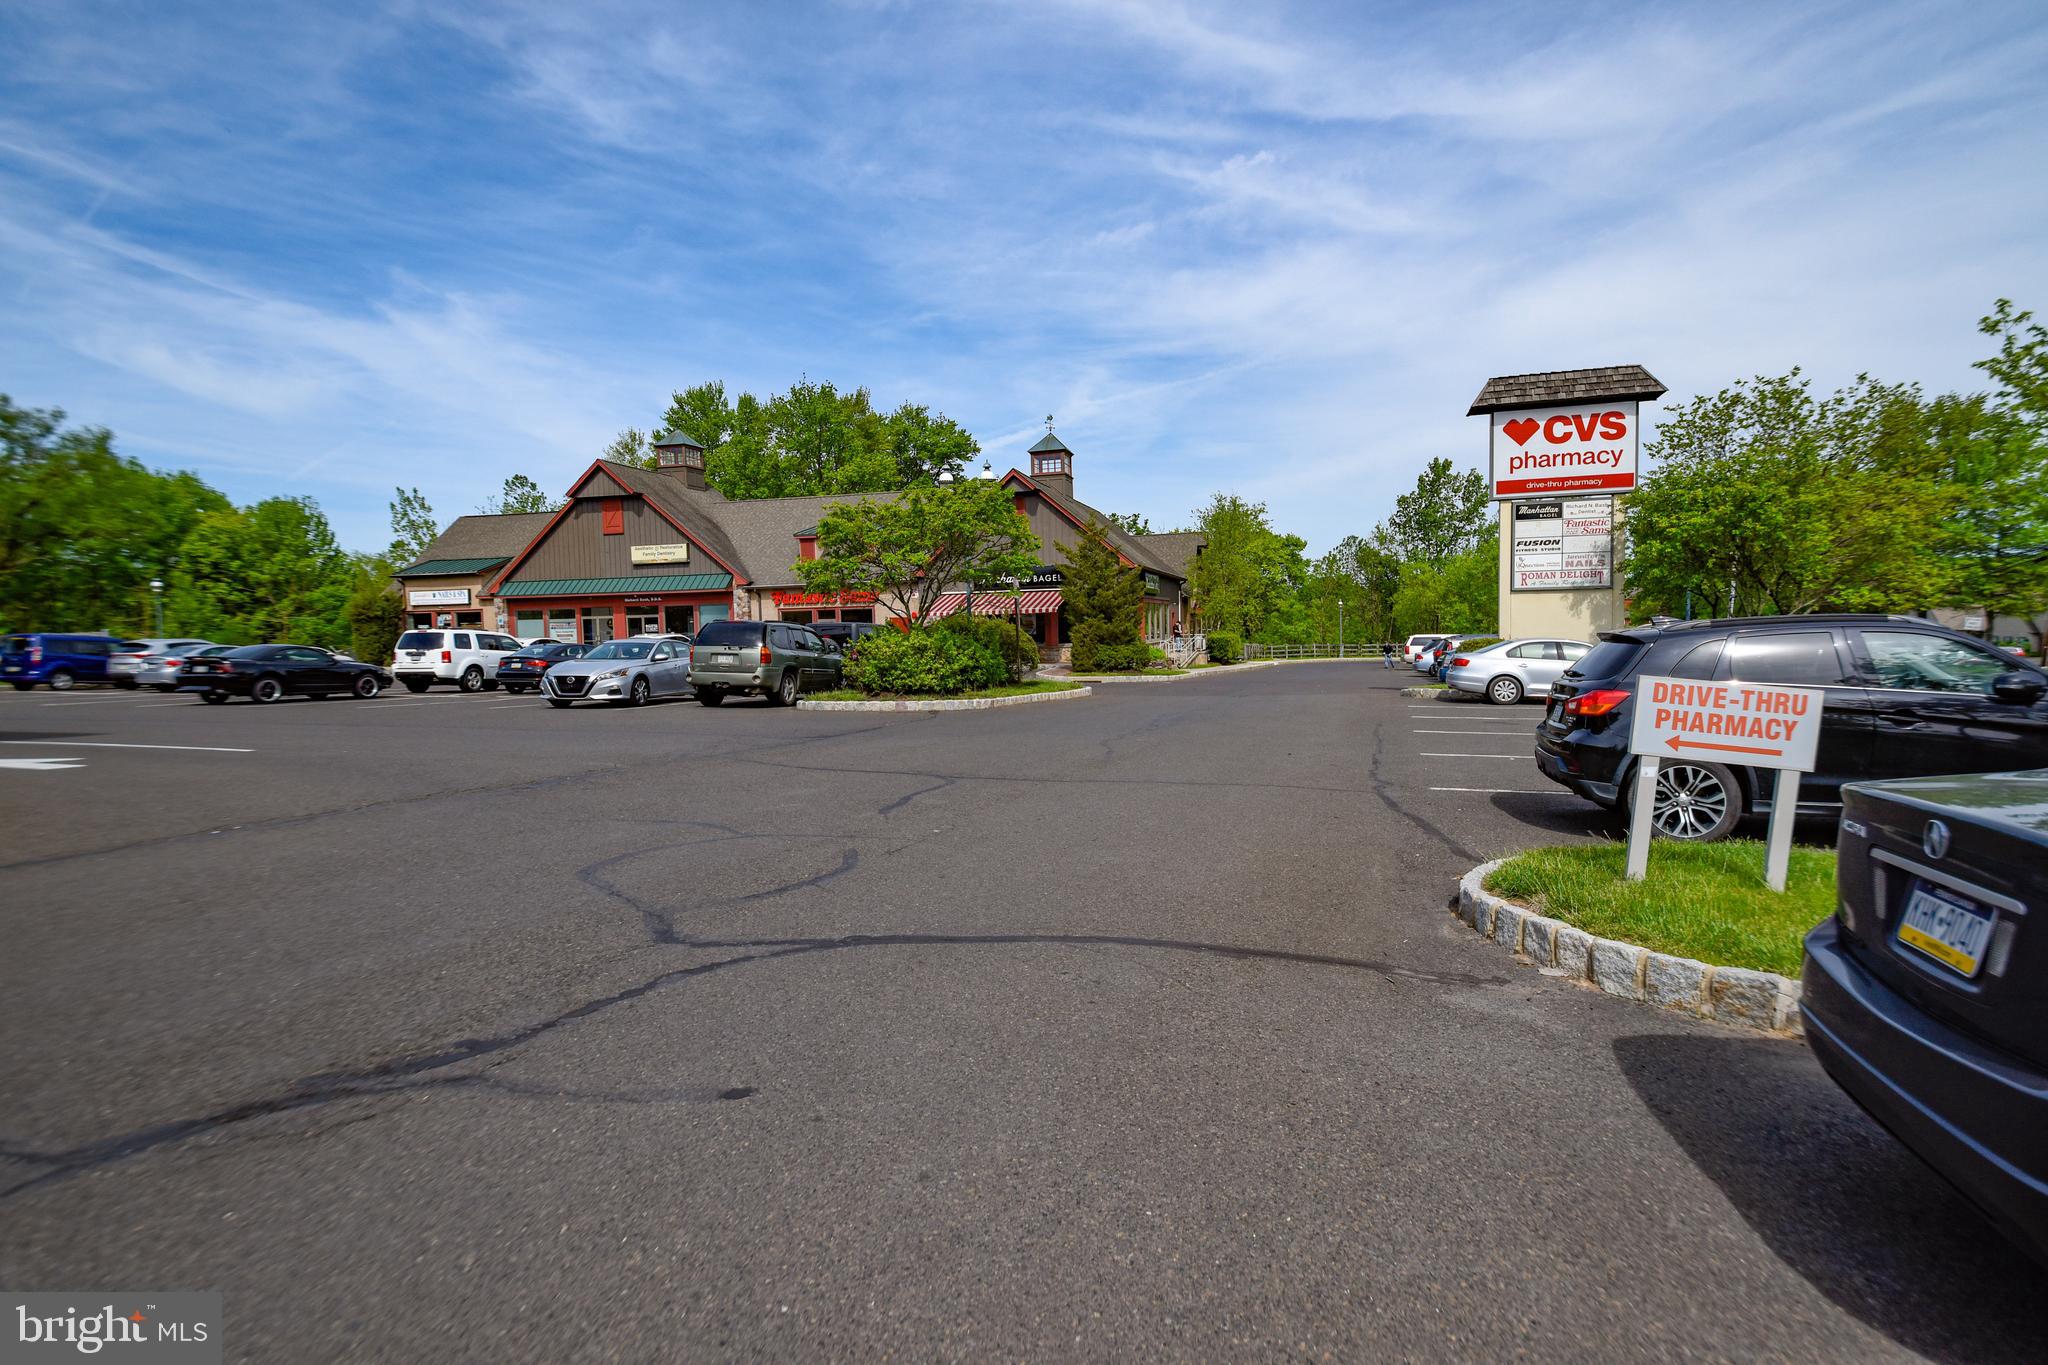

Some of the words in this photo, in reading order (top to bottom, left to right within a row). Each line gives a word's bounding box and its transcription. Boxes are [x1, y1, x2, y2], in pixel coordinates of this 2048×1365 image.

[1543, 411, 1627, 444] CVS
[1509, 448, 1624, 474] pharmacy
[1526, 480, 1562, 489] drive-thru
[1564, 478, 1603, 488] pharmacy
[1518, 505, 1559, 514] Manhattan
[1566, 519, 1610, 527] Fantastic
[1582, 526, 1611, 534] Sams
[1516, 539, 1561, 547] FUSION
[1565, 559, 1606, 568] NAILS
[1520, 571, 1556, 586] ROMAN
[1560, 570, 1604, 584] DELIGHT
[1652, 682, 1809, 716] DRIVE-THRU
[1655, 708, 1798, 741] PHARMACY
